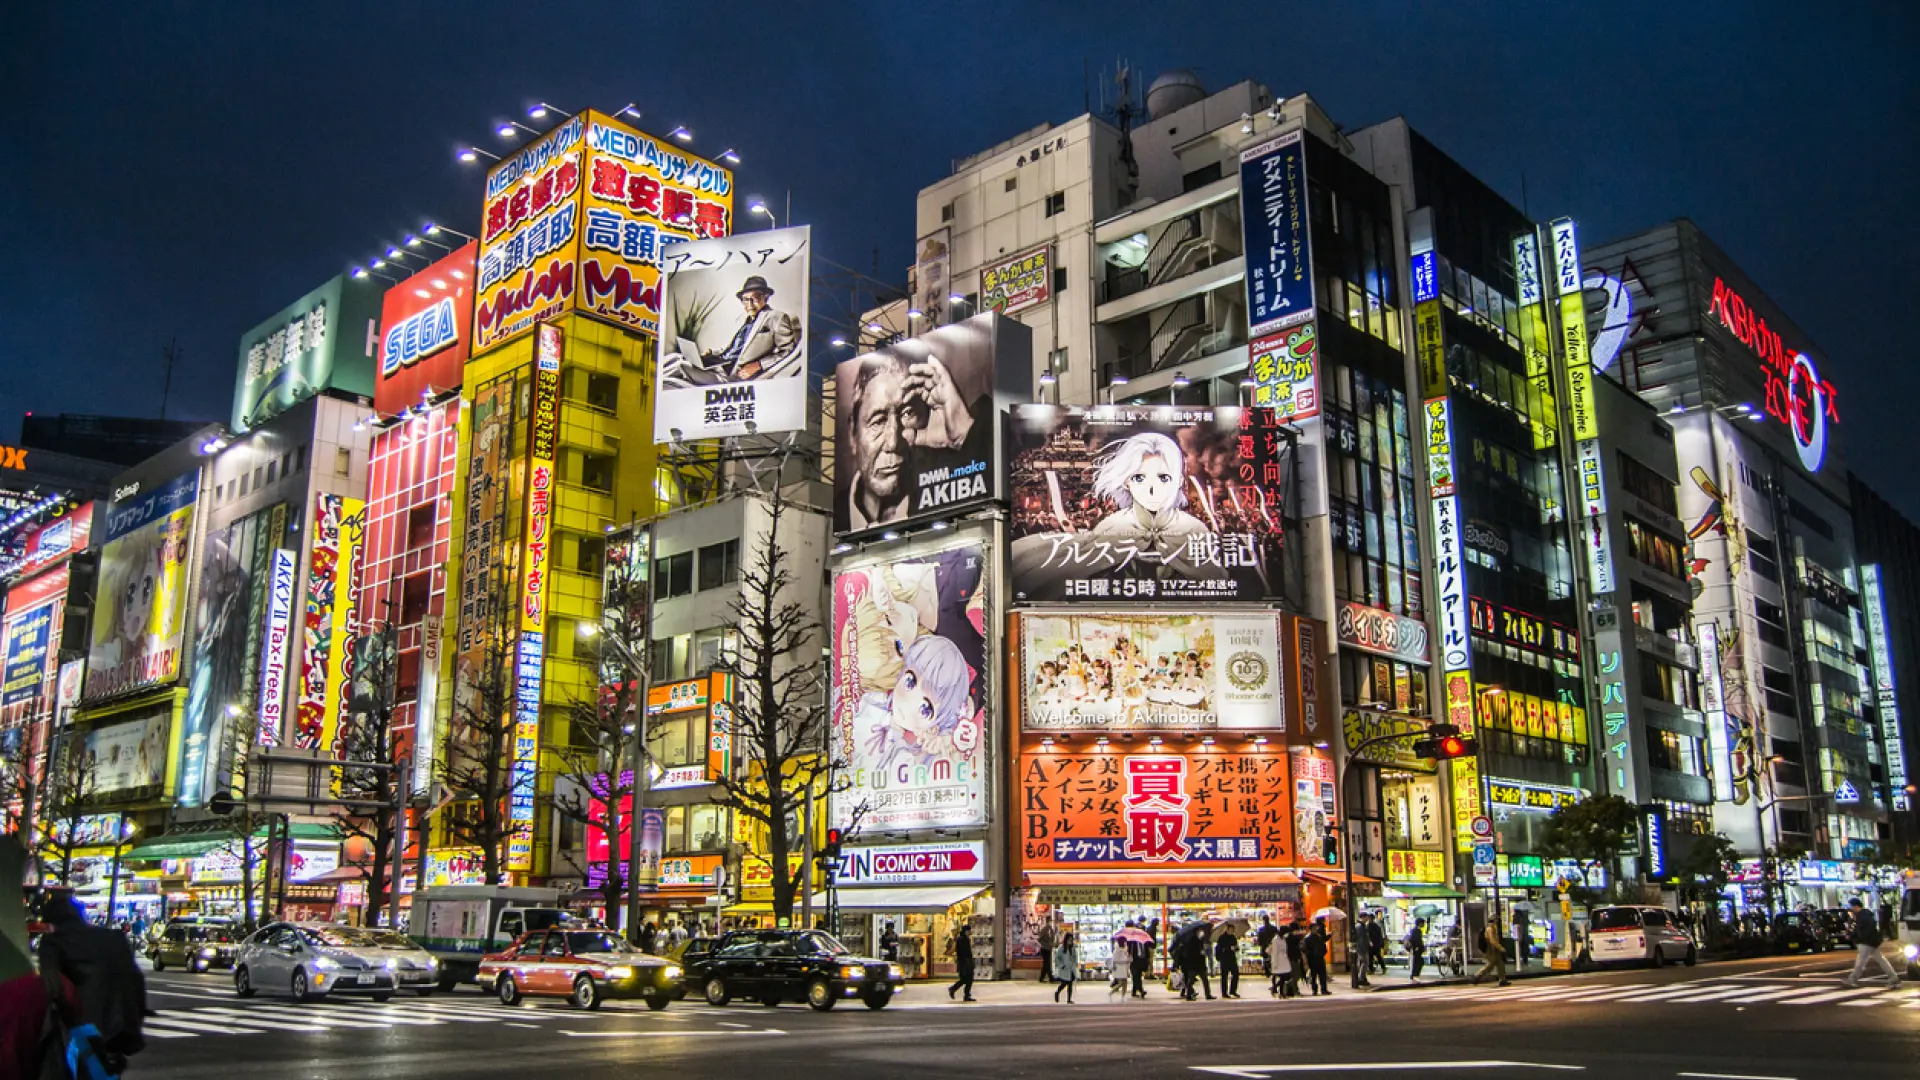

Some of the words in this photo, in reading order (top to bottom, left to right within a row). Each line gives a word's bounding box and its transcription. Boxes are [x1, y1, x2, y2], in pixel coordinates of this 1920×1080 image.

[488, 116, 584, 198] MEDIAリサイクル
[592, 124, 729, 195] MEDIAリサイクル
[486, 154, 581, 242] 激安販売
[590, 157, 727, 238] 激安販売
[481, 201, 575, 291] 高額買取
[477, 259, 574, 344] Mulan
[382, 296, 459, 379] SEGA
[1567, 325, 1579, 361] Yellow
[1254, 354, 1313, 382] まんが
[704, 403, 755, 425] 英会話
[705, 386, 756, 406] DMM
[918, 474, 989, 510] AKIBA
[1039, 531, 1259, 573] アルスラーン戦記
[273, 553, 293, 608] AKKY
[1160, 579, 1238, 591] TVアニメ放送中
[425, 617, 440, 659] GAME
[1339, 606, 1427, 657] メイドカジノ
[266, 624, 288, 701] Tax-free
[1032, 708, 1105, 725] Welcome
[1111, 710, 1126, 725] to
[1132, 708, 1218, 725] Akihabara
[1599, 651, 1627, 789] リバティー
[1053, 757, 1075, 834] アイドル
[1076, 758, 1097, 813] アニメ
[1098, 757, 1122, 836] 美少女系
[1127, 759, 1189, 861] 買取
[1192, 759, 1215, 836] フィギュア
[1214, 758, 1235, 812] ホビー
[1236, 758, 1261, 836] 携帯電話
[1261, 758, 1286, 860] アップルとか
[1419, 795, 1432, 841] ルノアール
[839, 849, 871, 881] ZIN
[875, 854, 926, 873] COMIC
[928, 853, 951, 871] ZIN
[1055, 839, 1123, 860] チケット
[1192, 839, 1258, 860] 大黒屋
[1477, 849, 1486, 860] P
